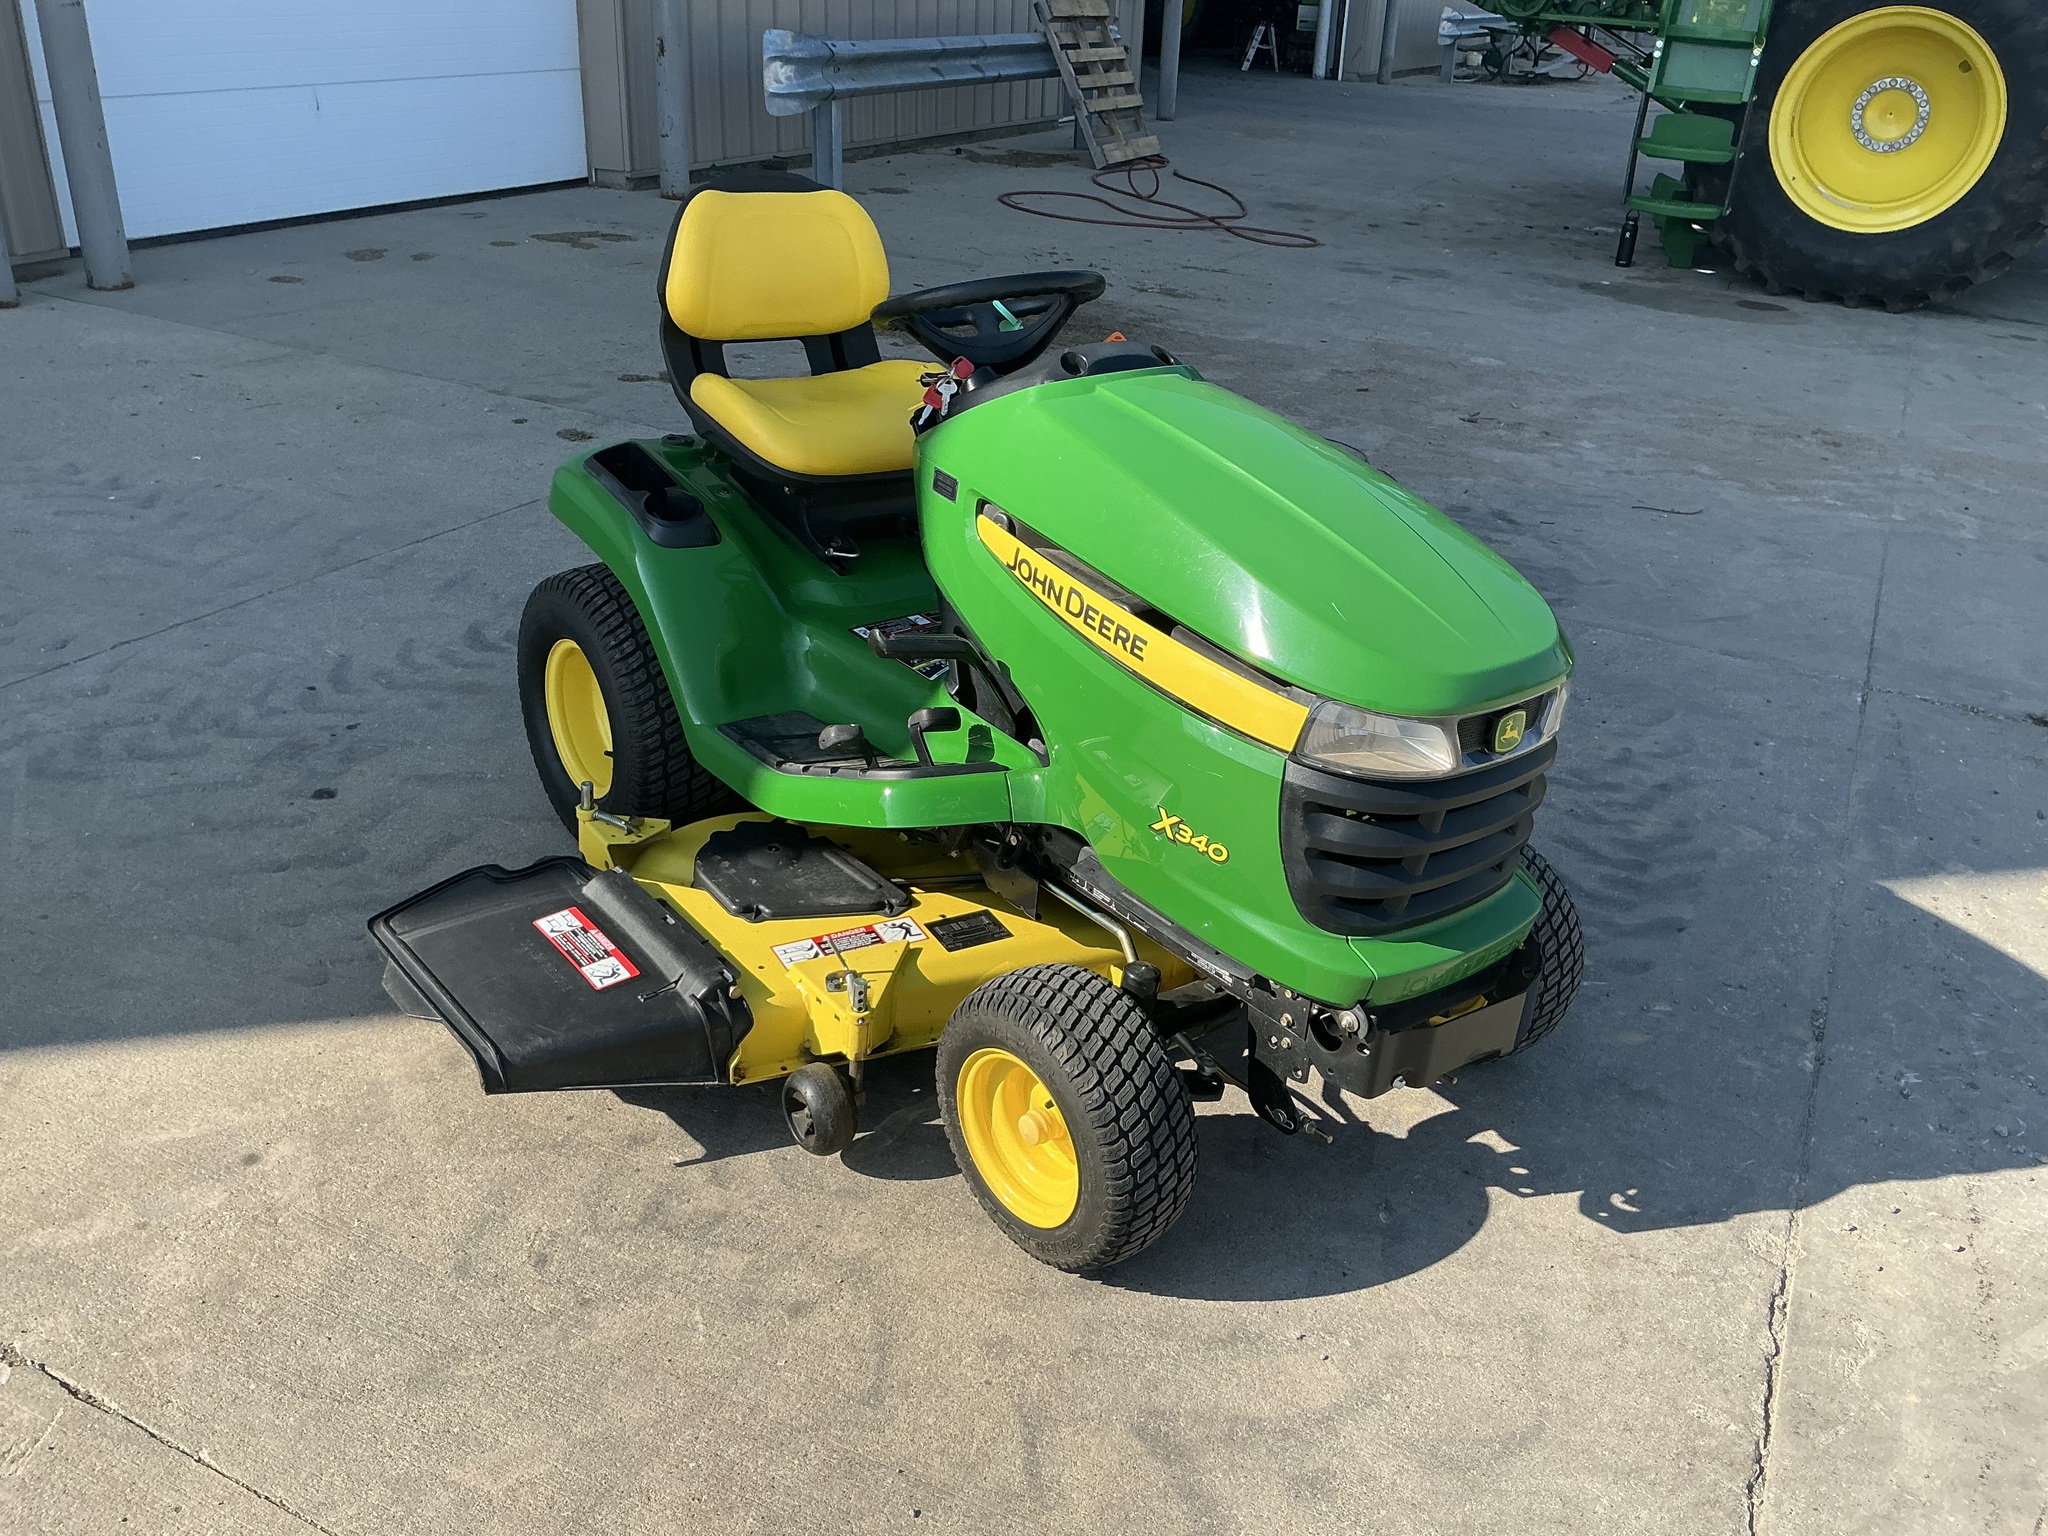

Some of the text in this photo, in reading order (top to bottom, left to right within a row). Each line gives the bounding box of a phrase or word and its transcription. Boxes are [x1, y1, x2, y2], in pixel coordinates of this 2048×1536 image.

[1005, 547, 1149, 663] JOHN DEERE
[1148, 804, 1231, 866] X340
[830, 926, 867, 940] DANGER
